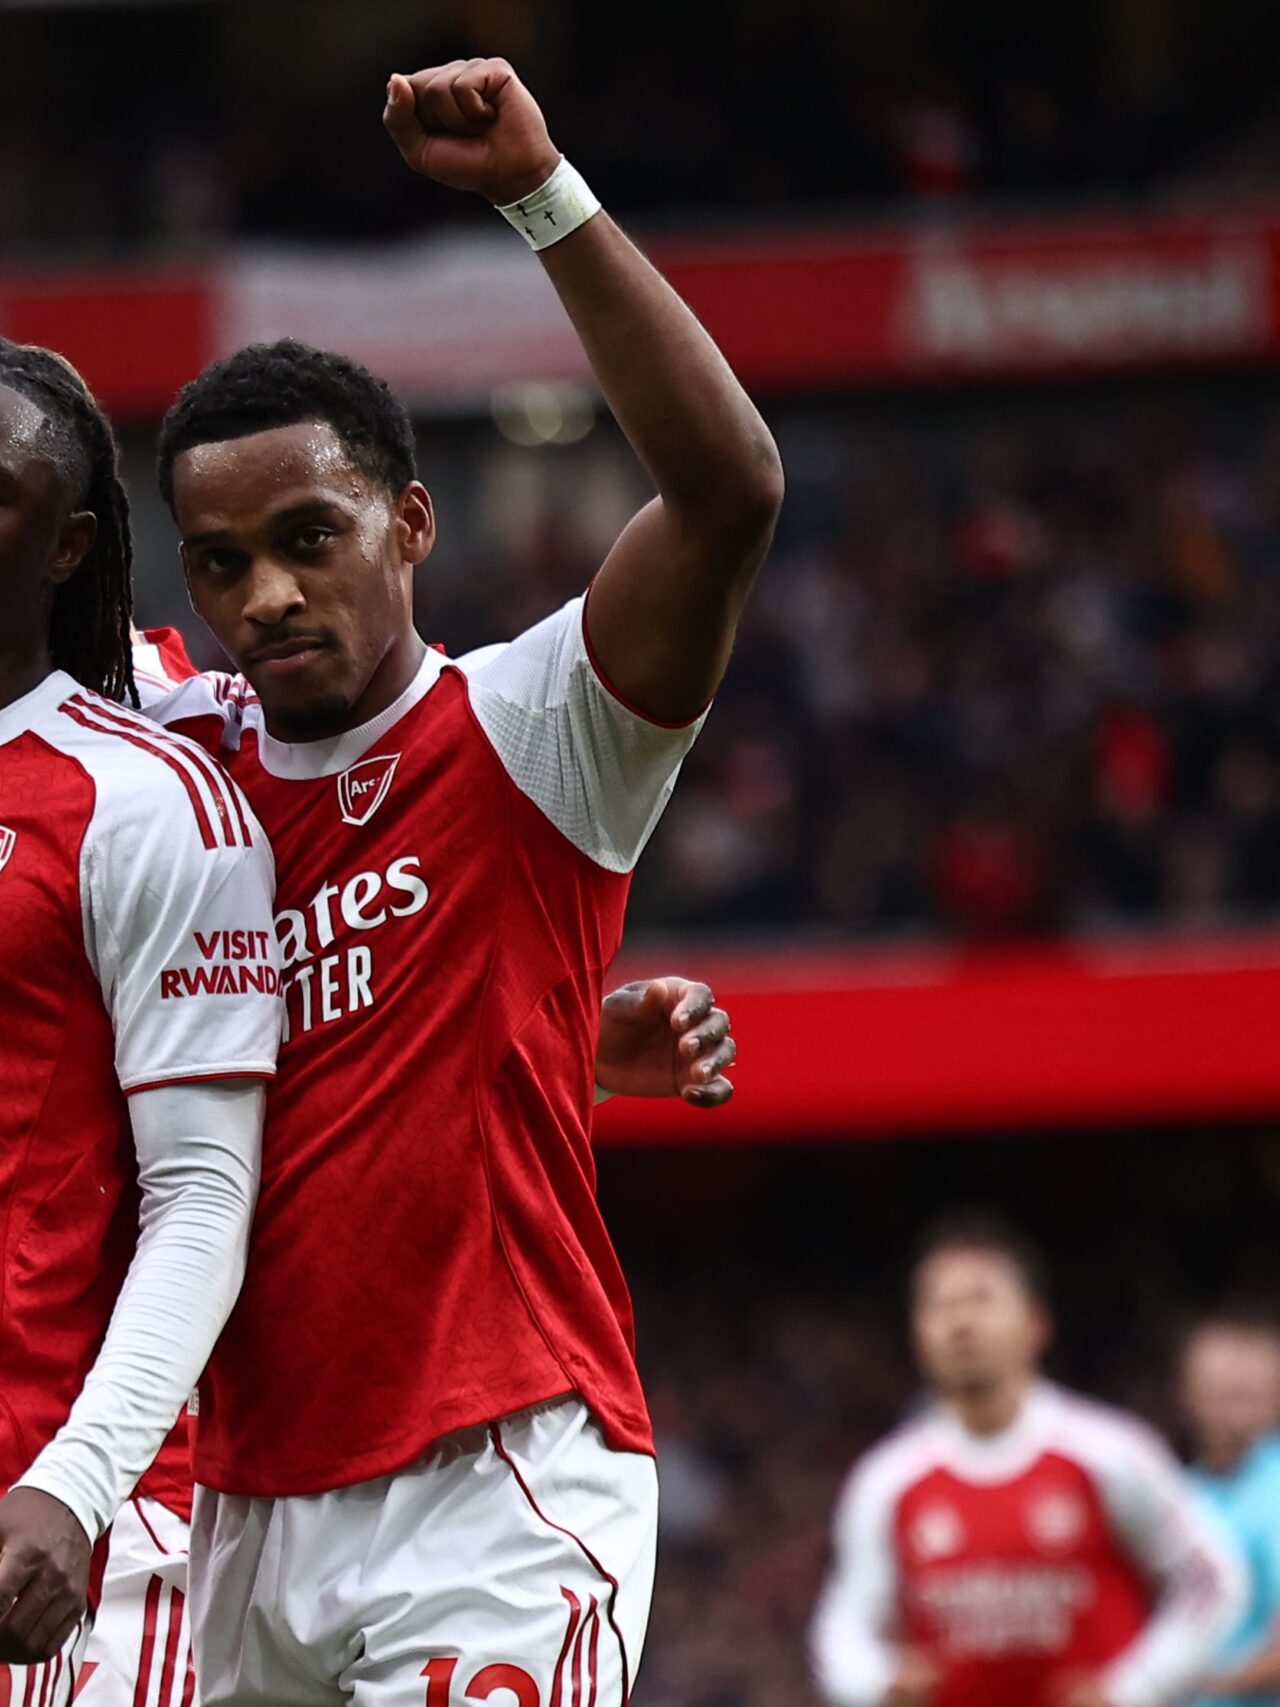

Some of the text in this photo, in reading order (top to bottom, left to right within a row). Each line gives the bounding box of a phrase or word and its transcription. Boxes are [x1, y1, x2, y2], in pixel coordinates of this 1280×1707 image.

[193, 930, 269, 960] VISIT
[273, 856, 429, 970] ates
[282, 945, 374, 1044] TTER
